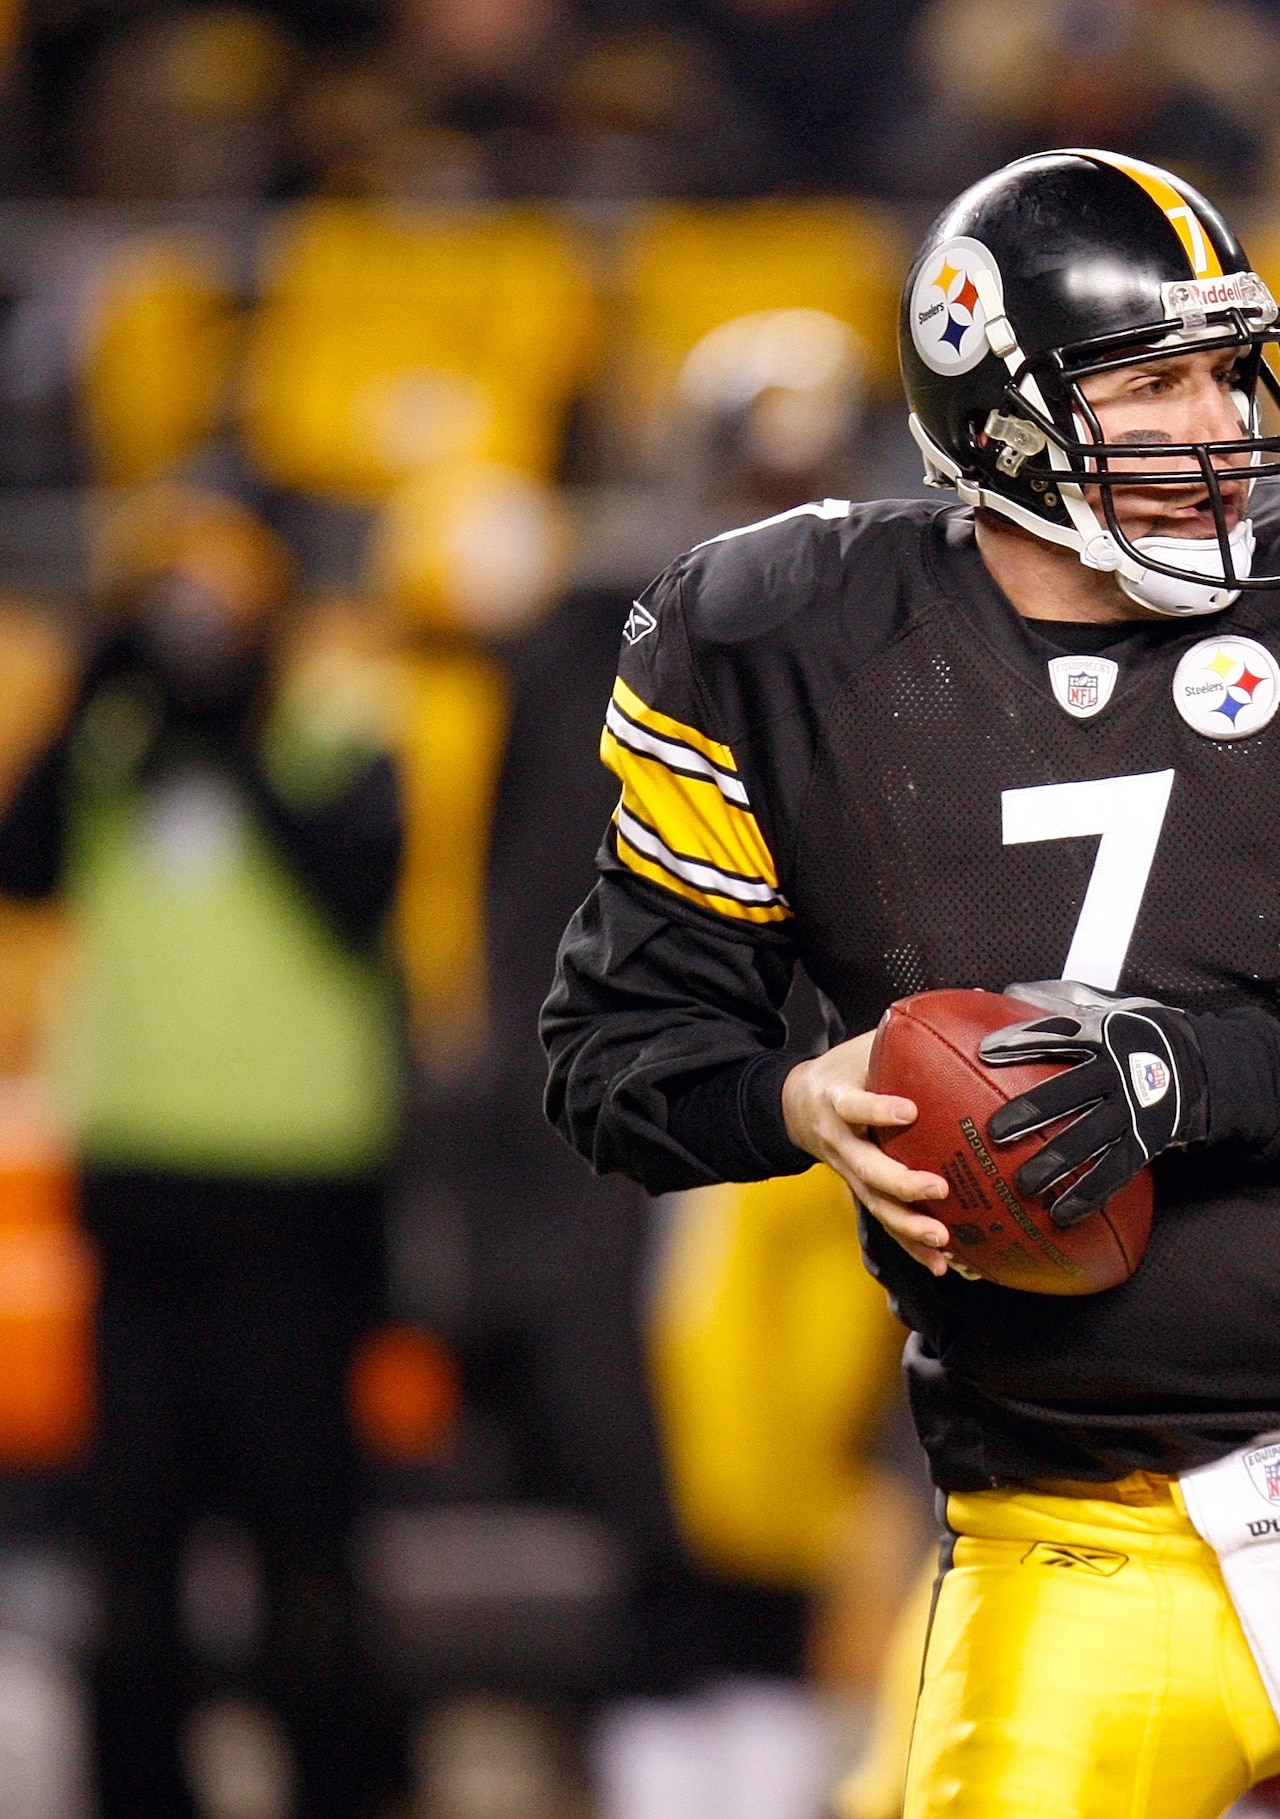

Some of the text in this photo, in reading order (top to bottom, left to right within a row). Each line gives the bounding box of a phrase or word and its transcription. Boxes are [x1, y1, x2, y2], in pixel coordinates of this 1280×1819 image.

[1165, 205, 1208, 274] 7
[918, 302, 944, 325] Steelers
[1070, 688, 1096, 705] NFL
[1185, 682, 1224, 697] Steelers
[1001, 768, 1175, 991] 7
[958, 1116, 999, 1176] LEAGUE
[994, 1178, 1042, 1240] FOOTBALL
